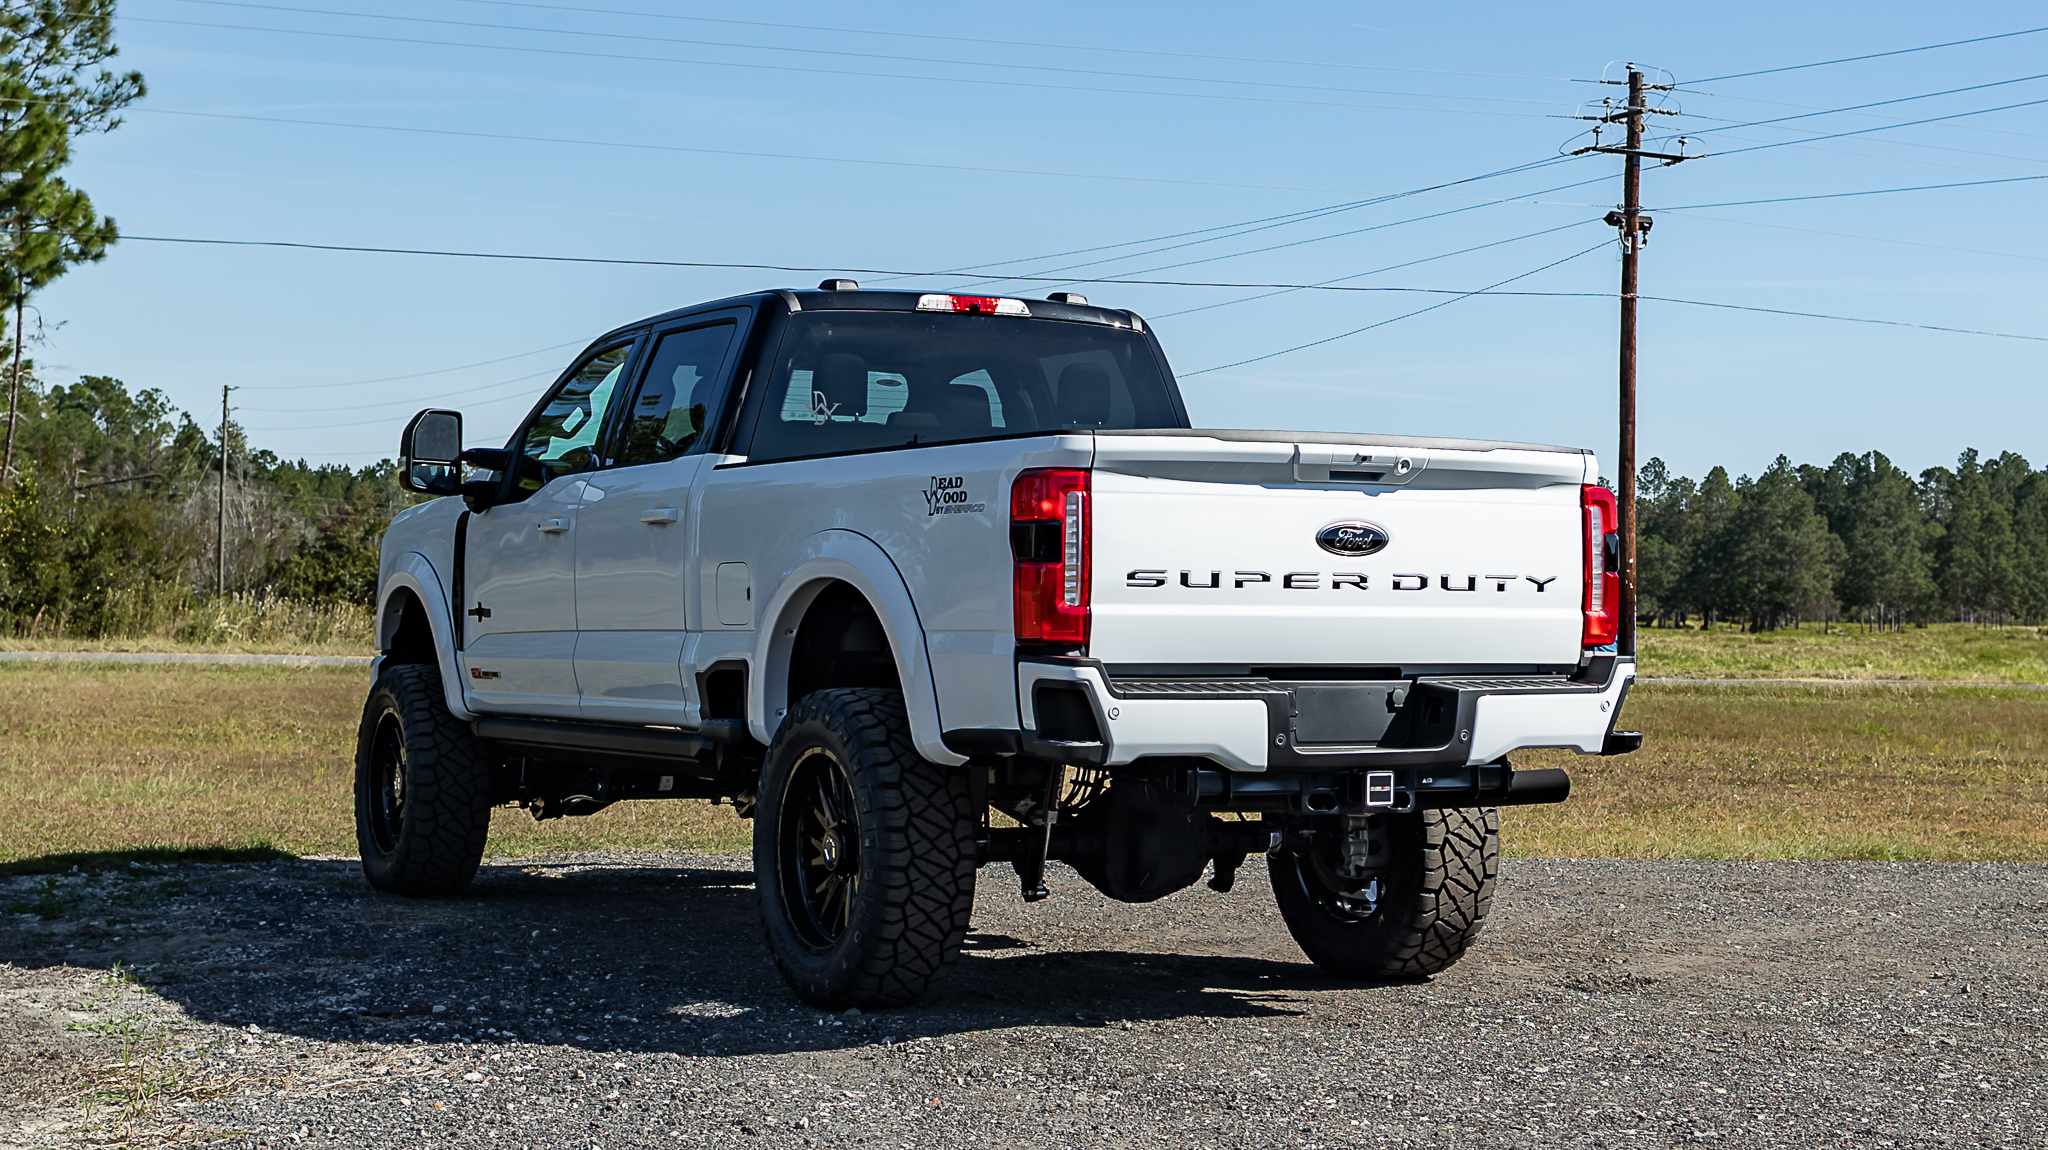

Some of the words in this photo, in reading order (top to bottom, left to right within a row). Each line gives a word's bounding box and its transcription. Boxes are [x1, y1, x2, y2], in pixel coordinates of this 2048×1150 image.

[930, 476, 964, 491] DEAD
[921, 489, 968, 504] WOOD
[936, 506, 944, 515] BY
[1334, 528, 1374, 549] Ford
[1126, 569, 1370, 590] SUPER
[1392, 573, 1558, 592] DUTY
